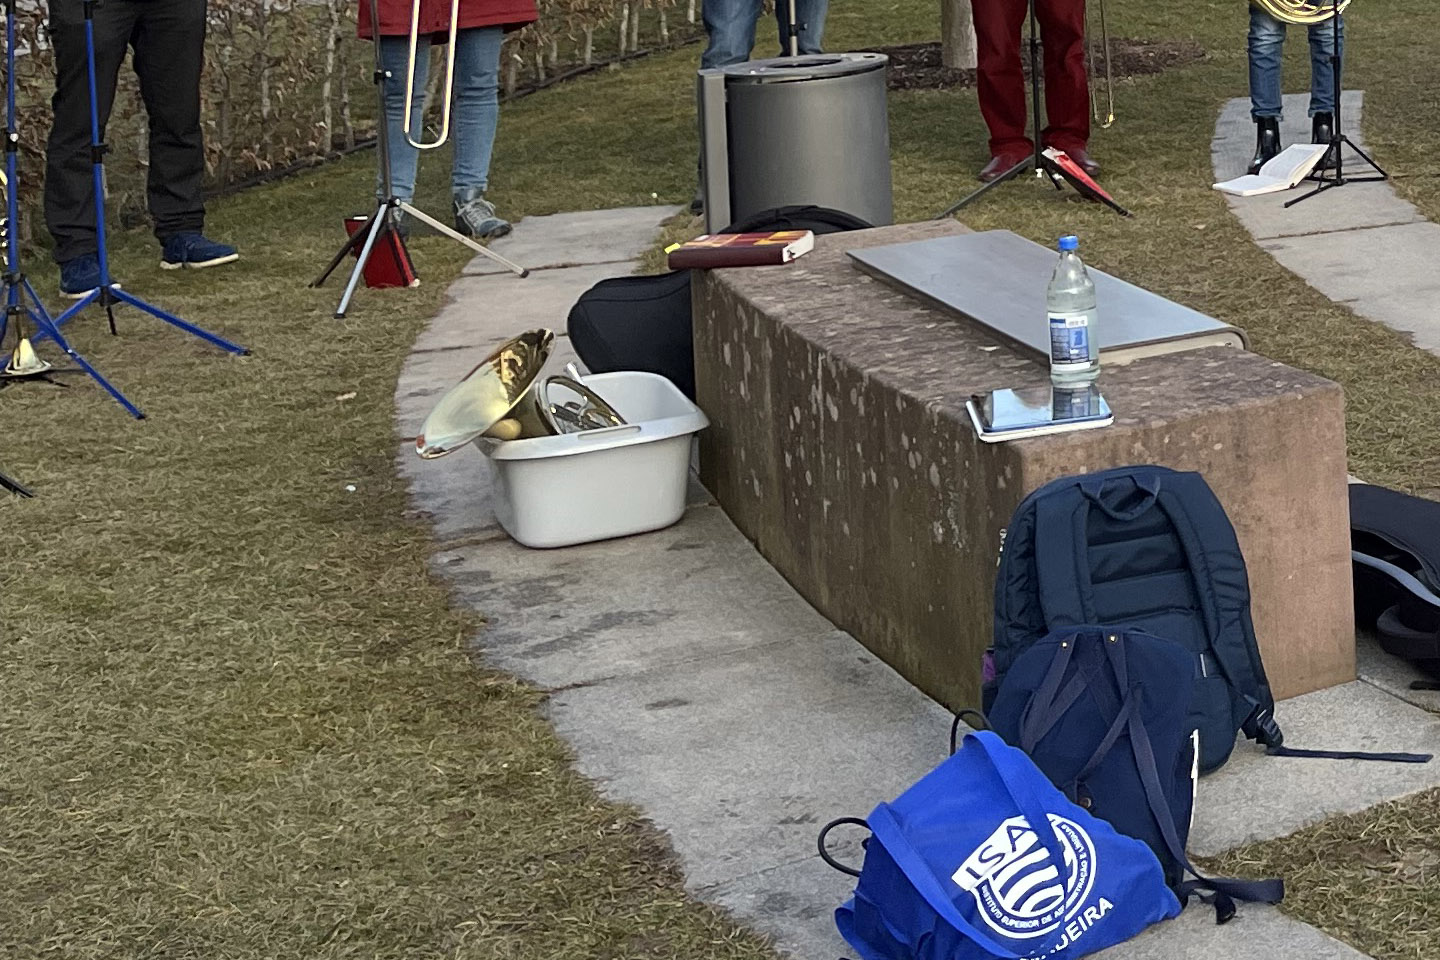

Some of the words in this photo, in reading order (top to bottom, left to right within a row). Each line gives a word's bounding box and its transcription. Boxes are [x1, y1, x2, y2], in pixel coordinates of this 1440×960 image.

[965, 825, 1032, 880] ISA
[1001, 915, 1040, 929] SUPERIOR
[1041, 915, 1053, 925] DE
